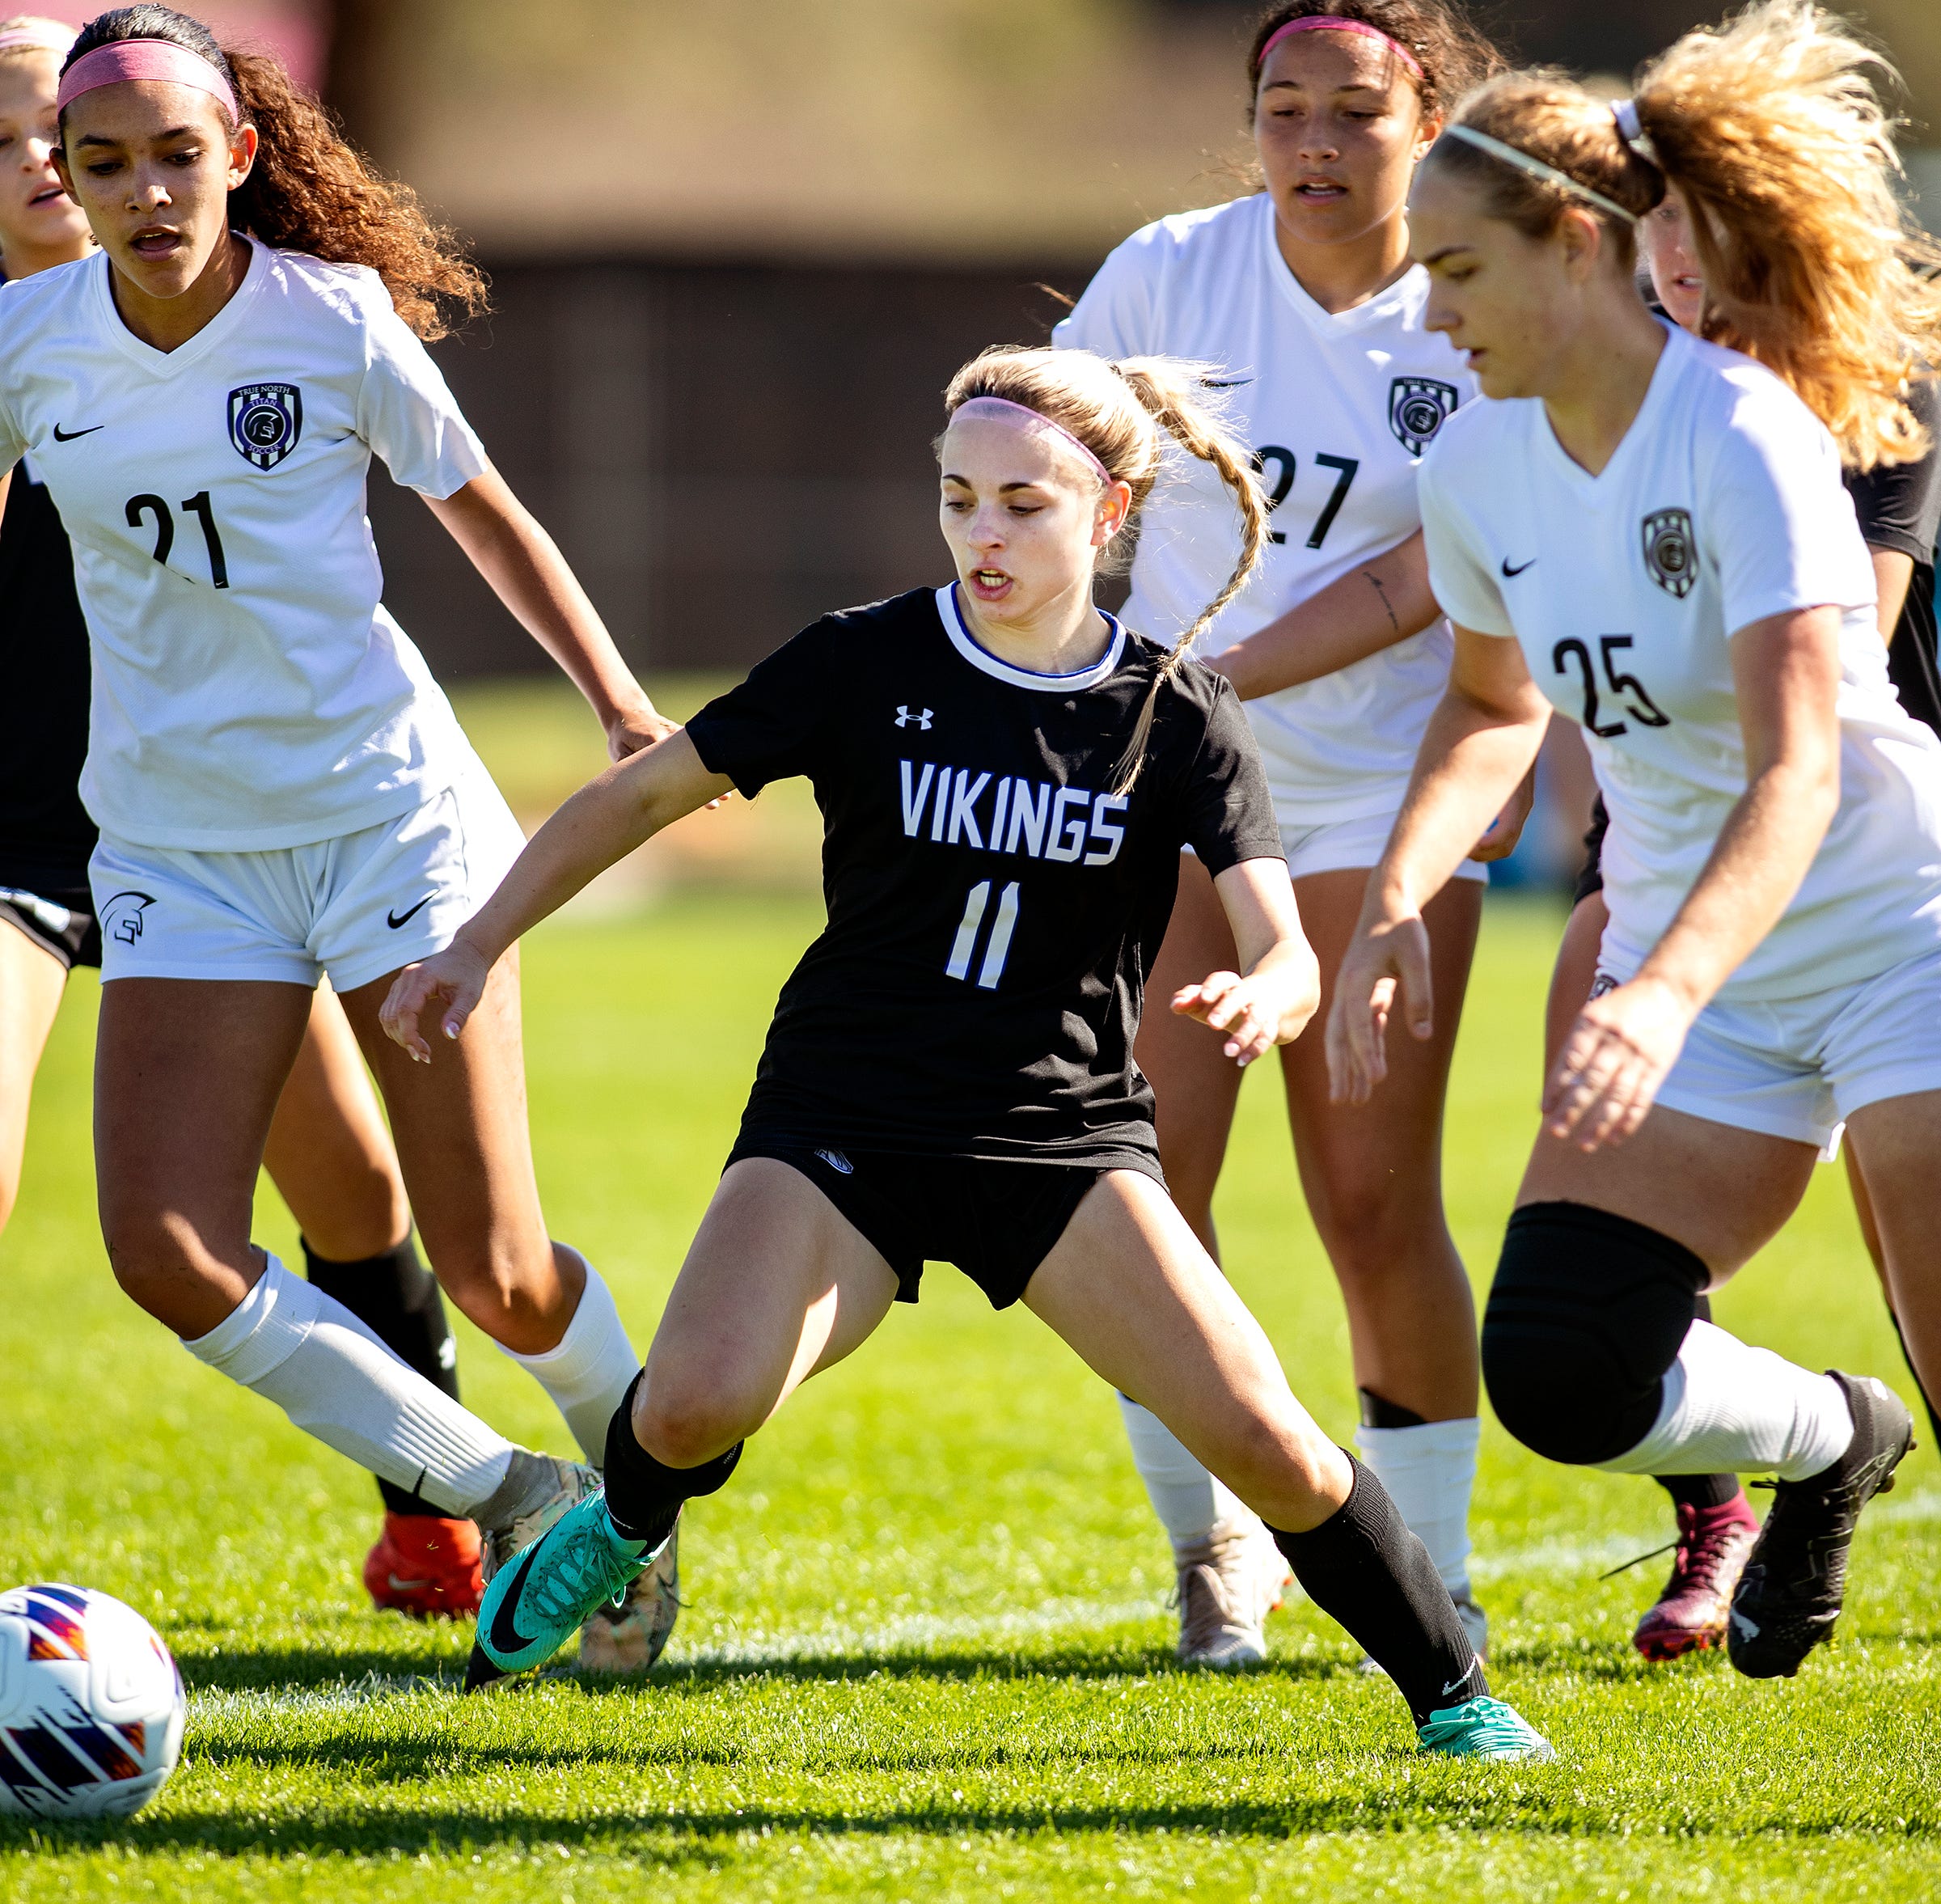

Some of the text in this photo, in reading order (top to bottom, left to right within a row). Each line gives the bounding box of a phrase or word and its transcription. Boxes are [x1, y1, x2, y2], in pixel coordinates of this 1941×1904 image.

[238, 385, 290, 396] TRUE NORTH
[249, 397, 277, 407] TITAN
[247, 444, 281, 455] SOCCER
[1251, 446, 1360, 549] 27
[125, 490, 230, 590] 21
[1552, 636, 1671, 738] 25
[899, 758, 1129, 866] VIKINGS
[944, 878, 1021, 991] 11
